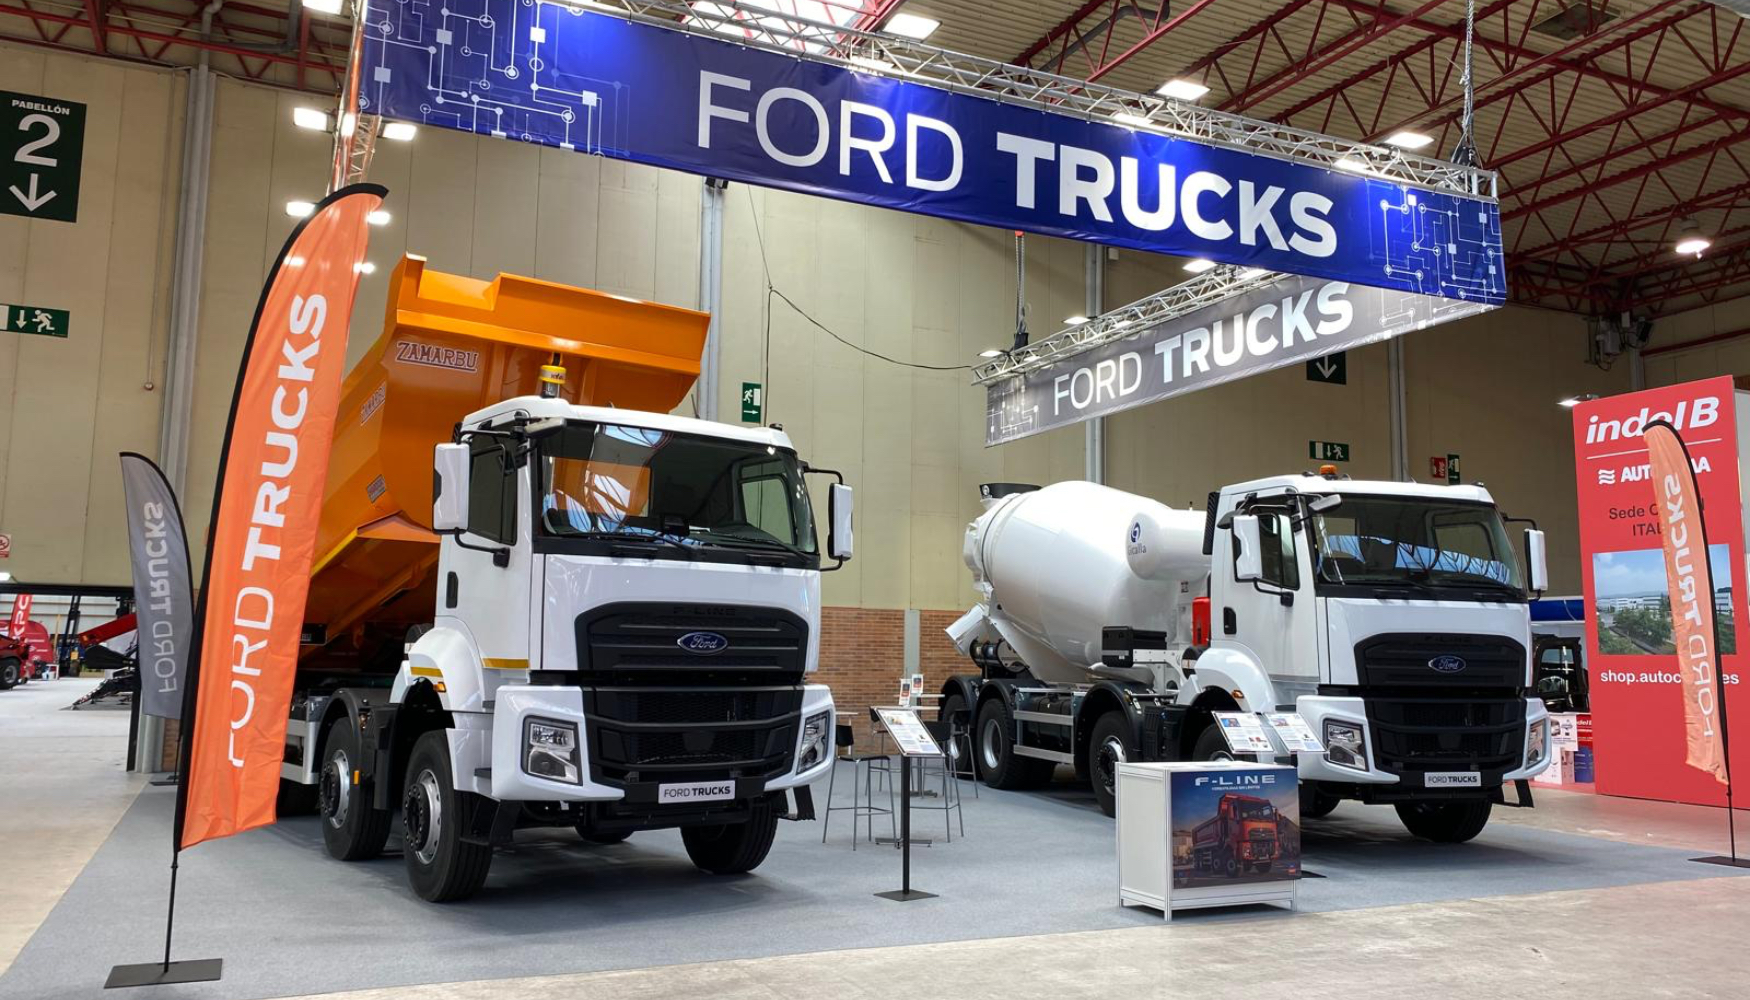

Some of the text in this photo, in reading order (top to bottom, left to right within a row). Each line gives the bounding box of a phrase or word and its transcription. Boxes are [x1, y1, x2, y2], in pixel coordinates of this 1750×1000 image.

[12, 99, 70, 115] PABELLÓN
[14, 113, 60, 167] 2
[698, 70, 1337, 258] FORD TRUCKS
[397, 341, 478, 369] ZAMARBU
[1054, 281, 1353, 416] FORD TRUCKS
[241, 294, 327, 571] TRUCKS
[1609, 505, 1645, 520] Sede
[690, 634, 718, 649] Ford
[1194, 774, 1275, 786] F-LINE
[1427, 775, 1478, 784] FORD TRUCKS
[664, 785, 731, 798] FORD TRUCKS
